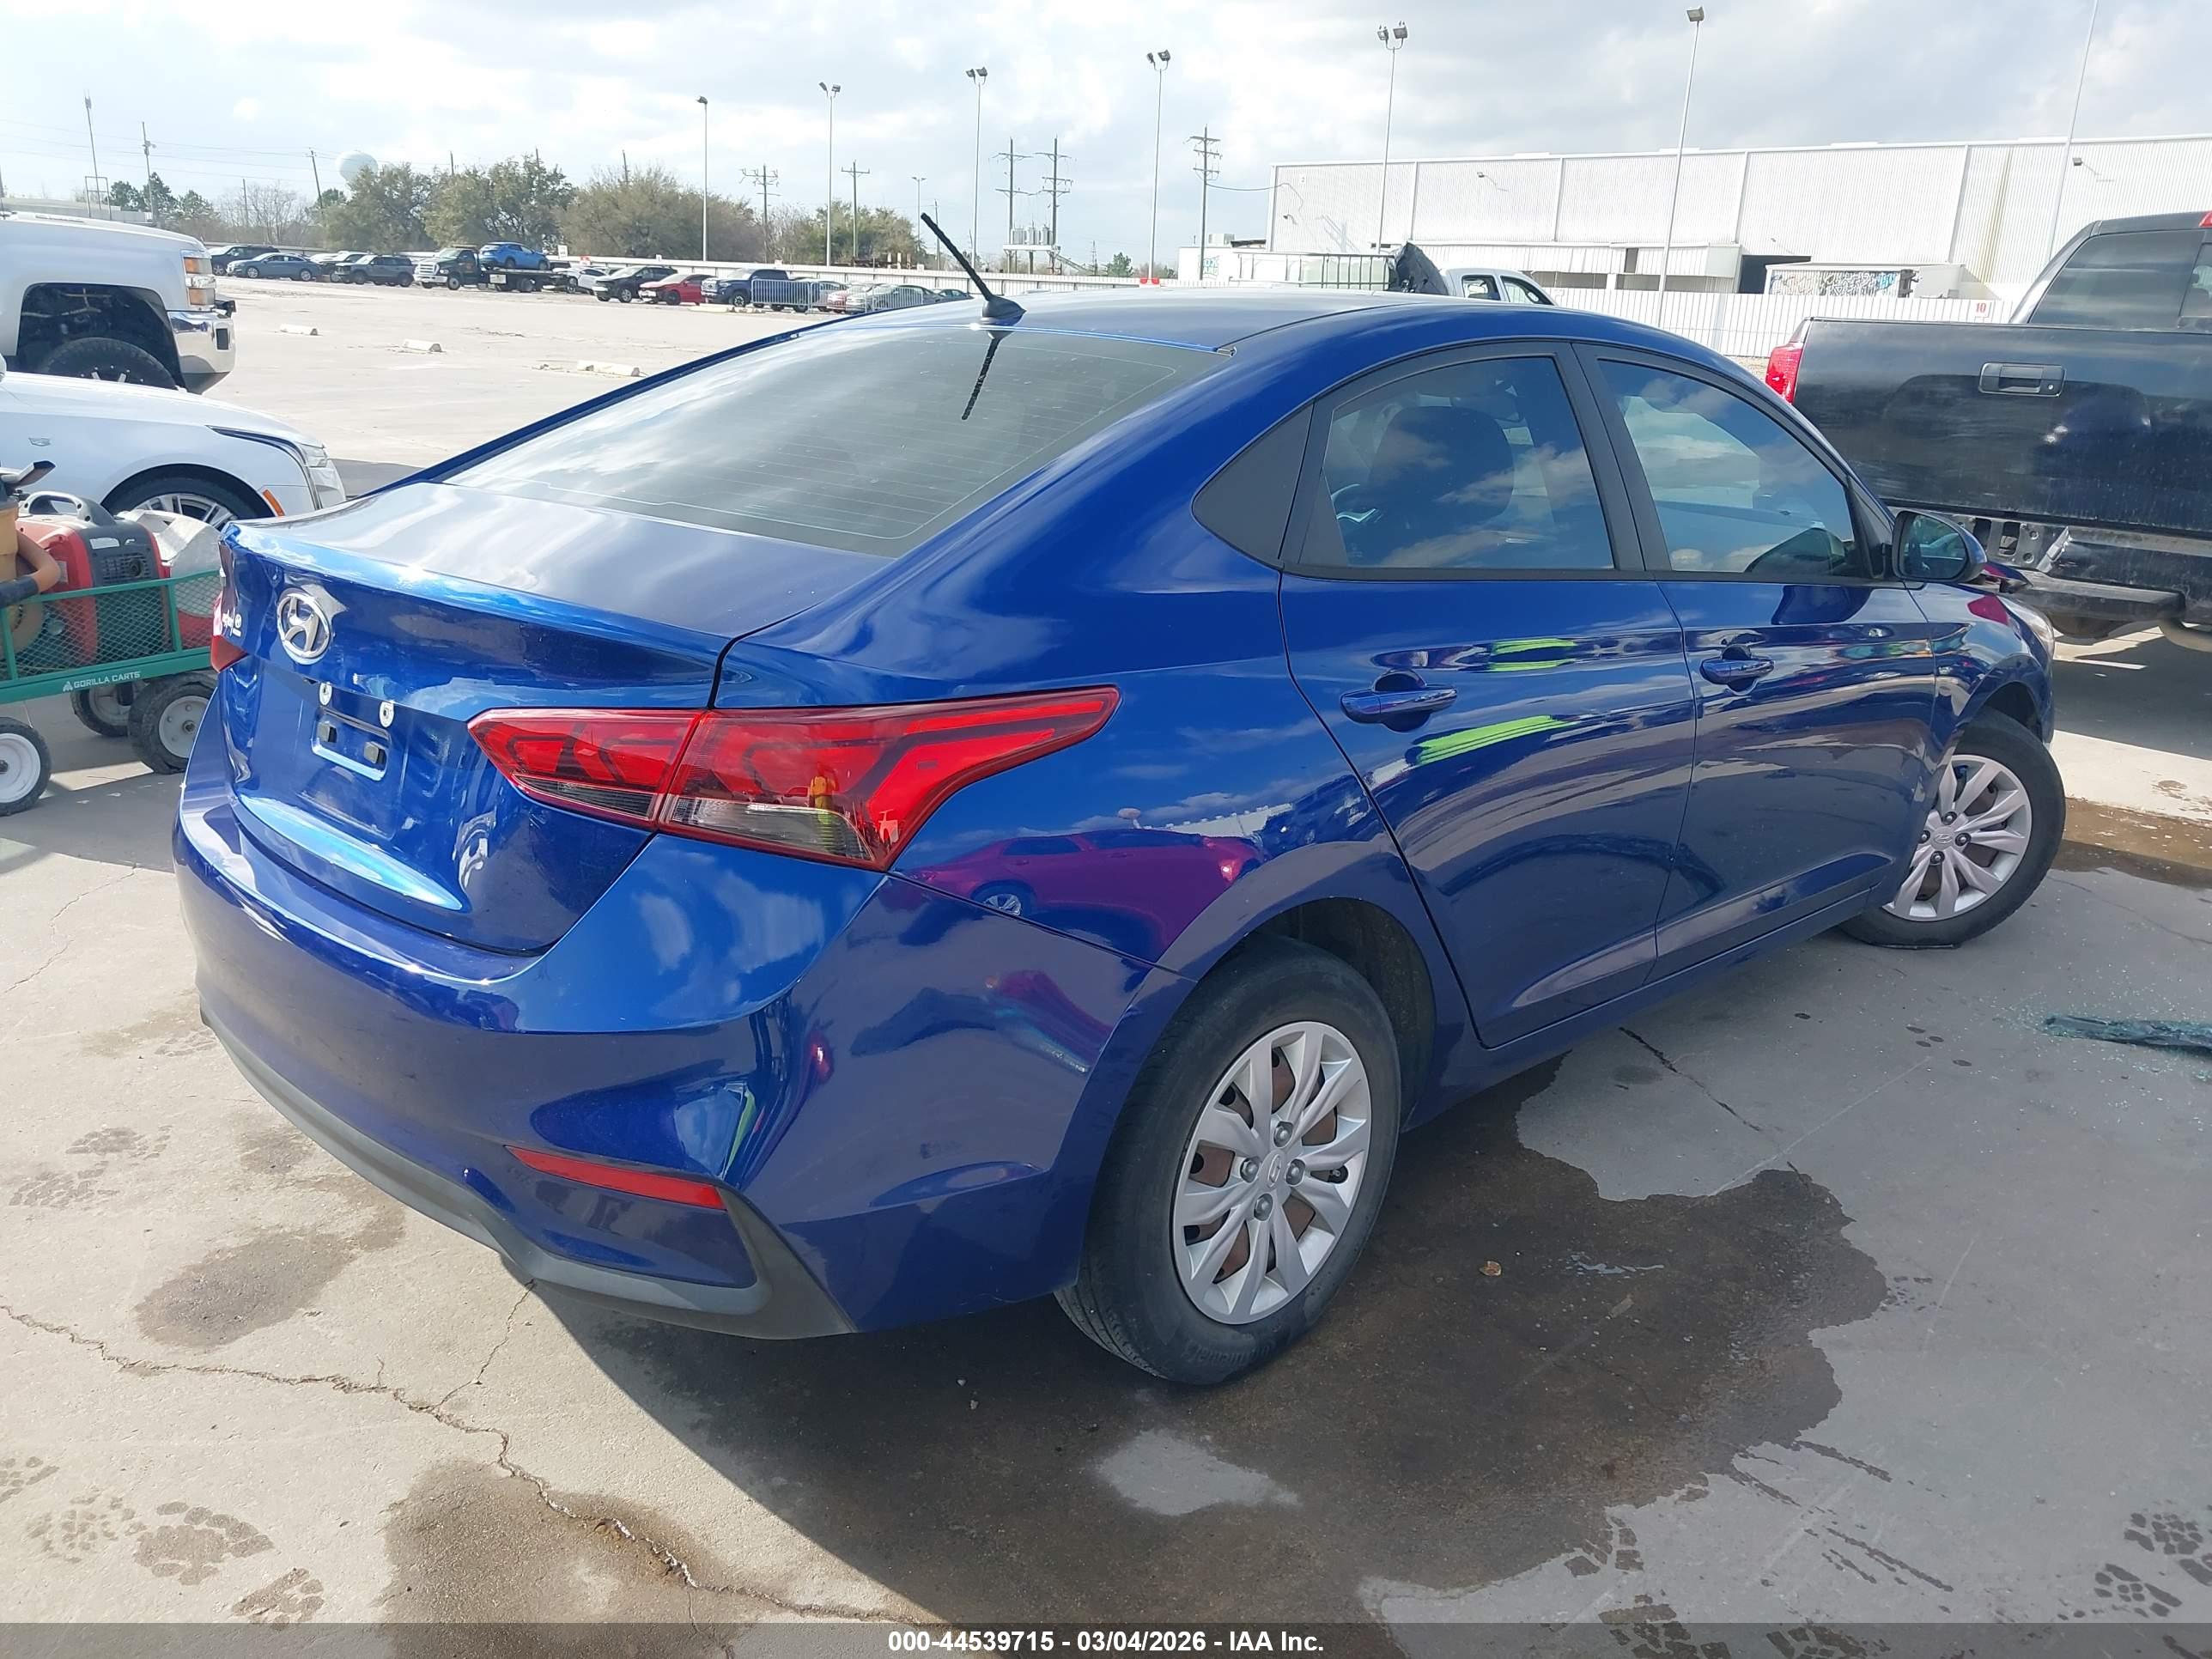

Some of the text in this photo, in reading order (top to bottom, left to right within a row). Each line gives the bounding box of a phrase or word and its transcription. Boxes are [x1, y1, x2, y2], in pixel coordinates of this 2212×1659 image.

[1975, 302, 1987, 313] 10
[73, 671, 141, 689] GORILLA CARTS
